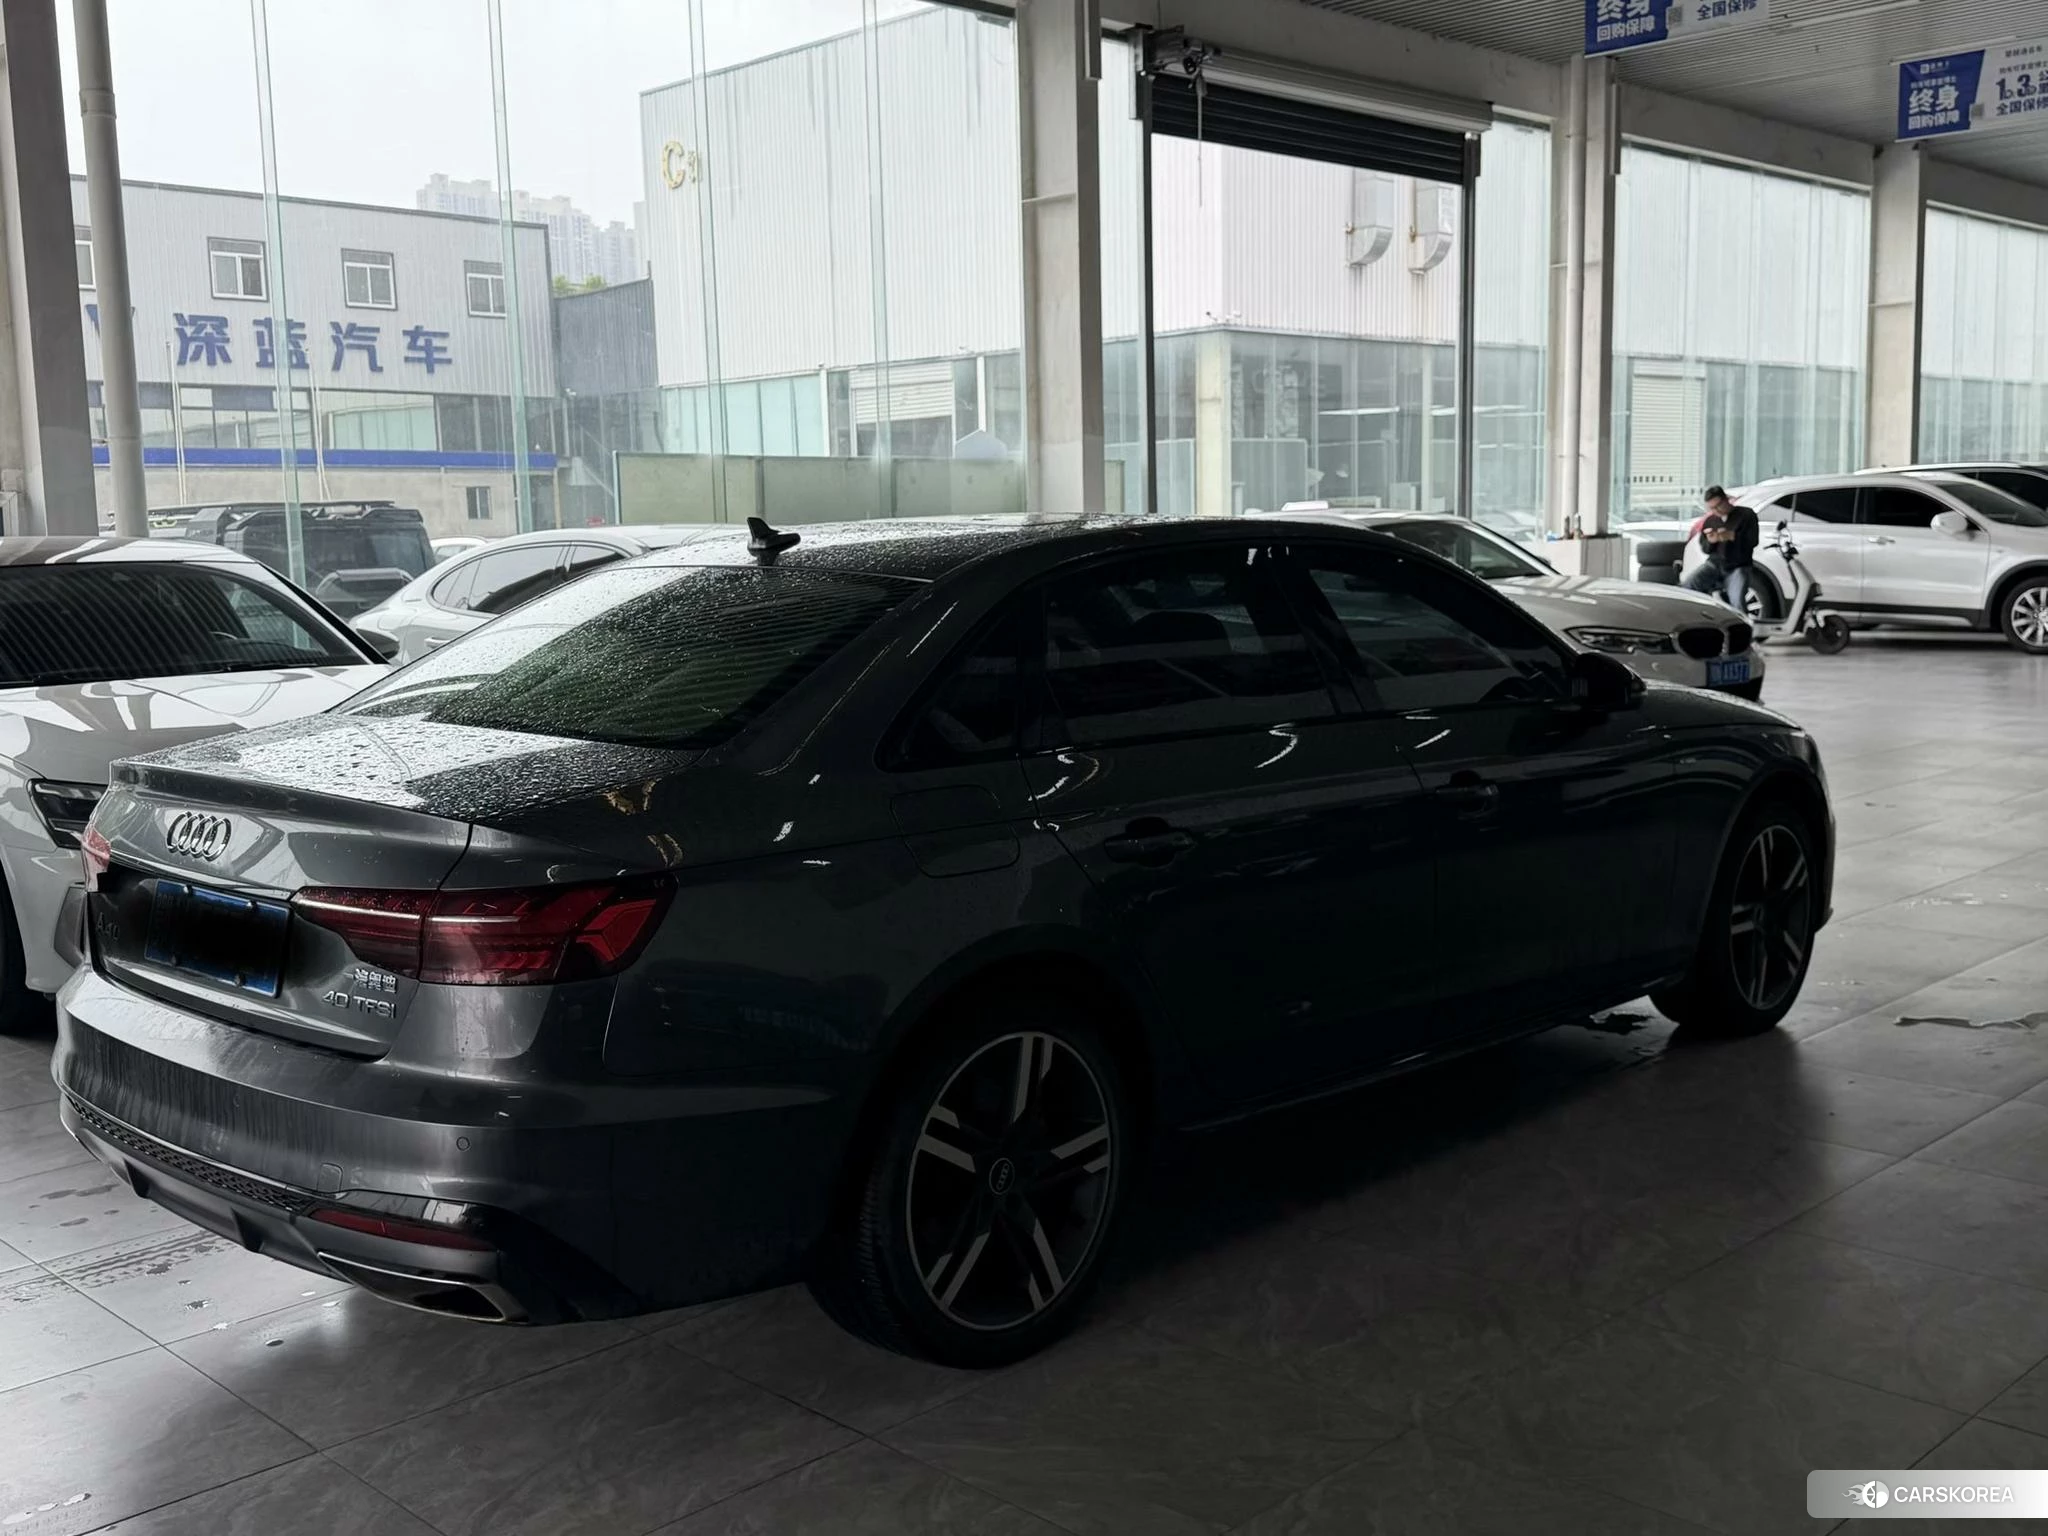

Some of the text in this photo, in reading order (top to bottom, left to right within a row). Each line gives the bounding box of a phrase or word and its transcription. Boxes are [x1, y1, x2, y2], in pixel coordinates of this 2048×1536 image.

[1597, 15, 1655, 42] 回购保障
[1909, 84, 1959, 114] 终身
[1908, 109, 1959, 130] 回购保障
[173, 312, 453, 374] 深蓝汽车
[322, 990, 395, 1019] 40 TFSI
